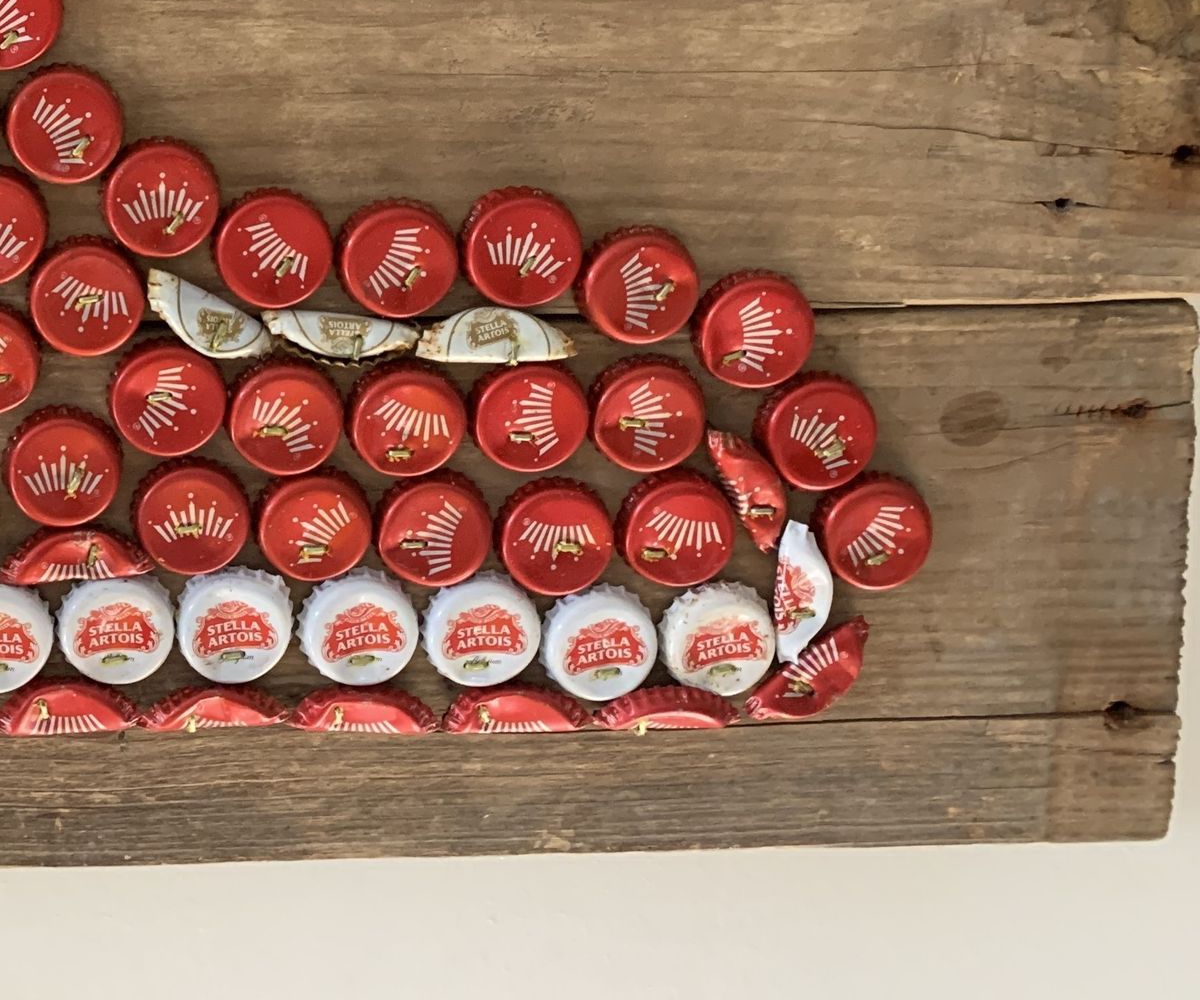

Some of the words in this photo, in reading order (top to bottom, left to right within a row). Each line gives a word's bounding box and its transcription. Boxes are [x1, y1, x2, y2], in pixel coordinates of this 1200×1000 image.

[475, 320, 508, 336] STELLA
[477, 327, 510, 342] ARTOIS
[89, 622, 142, 635] STELLA
[207, 620, 261, 635] STELLA
[335, 622, 388, 640] STELLA
[457, 625, 510, 638] STELLA
[89, 633, 144, 648] ARTOIS
[208, 632, 262, 647] ARTOIS
[337, 634, 391, 652] ARTOIS
[457, 636, 511, 650] ARTOIS
[578, 638, 630, 654] STELLA
[697, 632, 749, 650] STELLA
[578, 648, 632, 664] ARTOIS
[698, 641, 751, 661] ARTOIS
